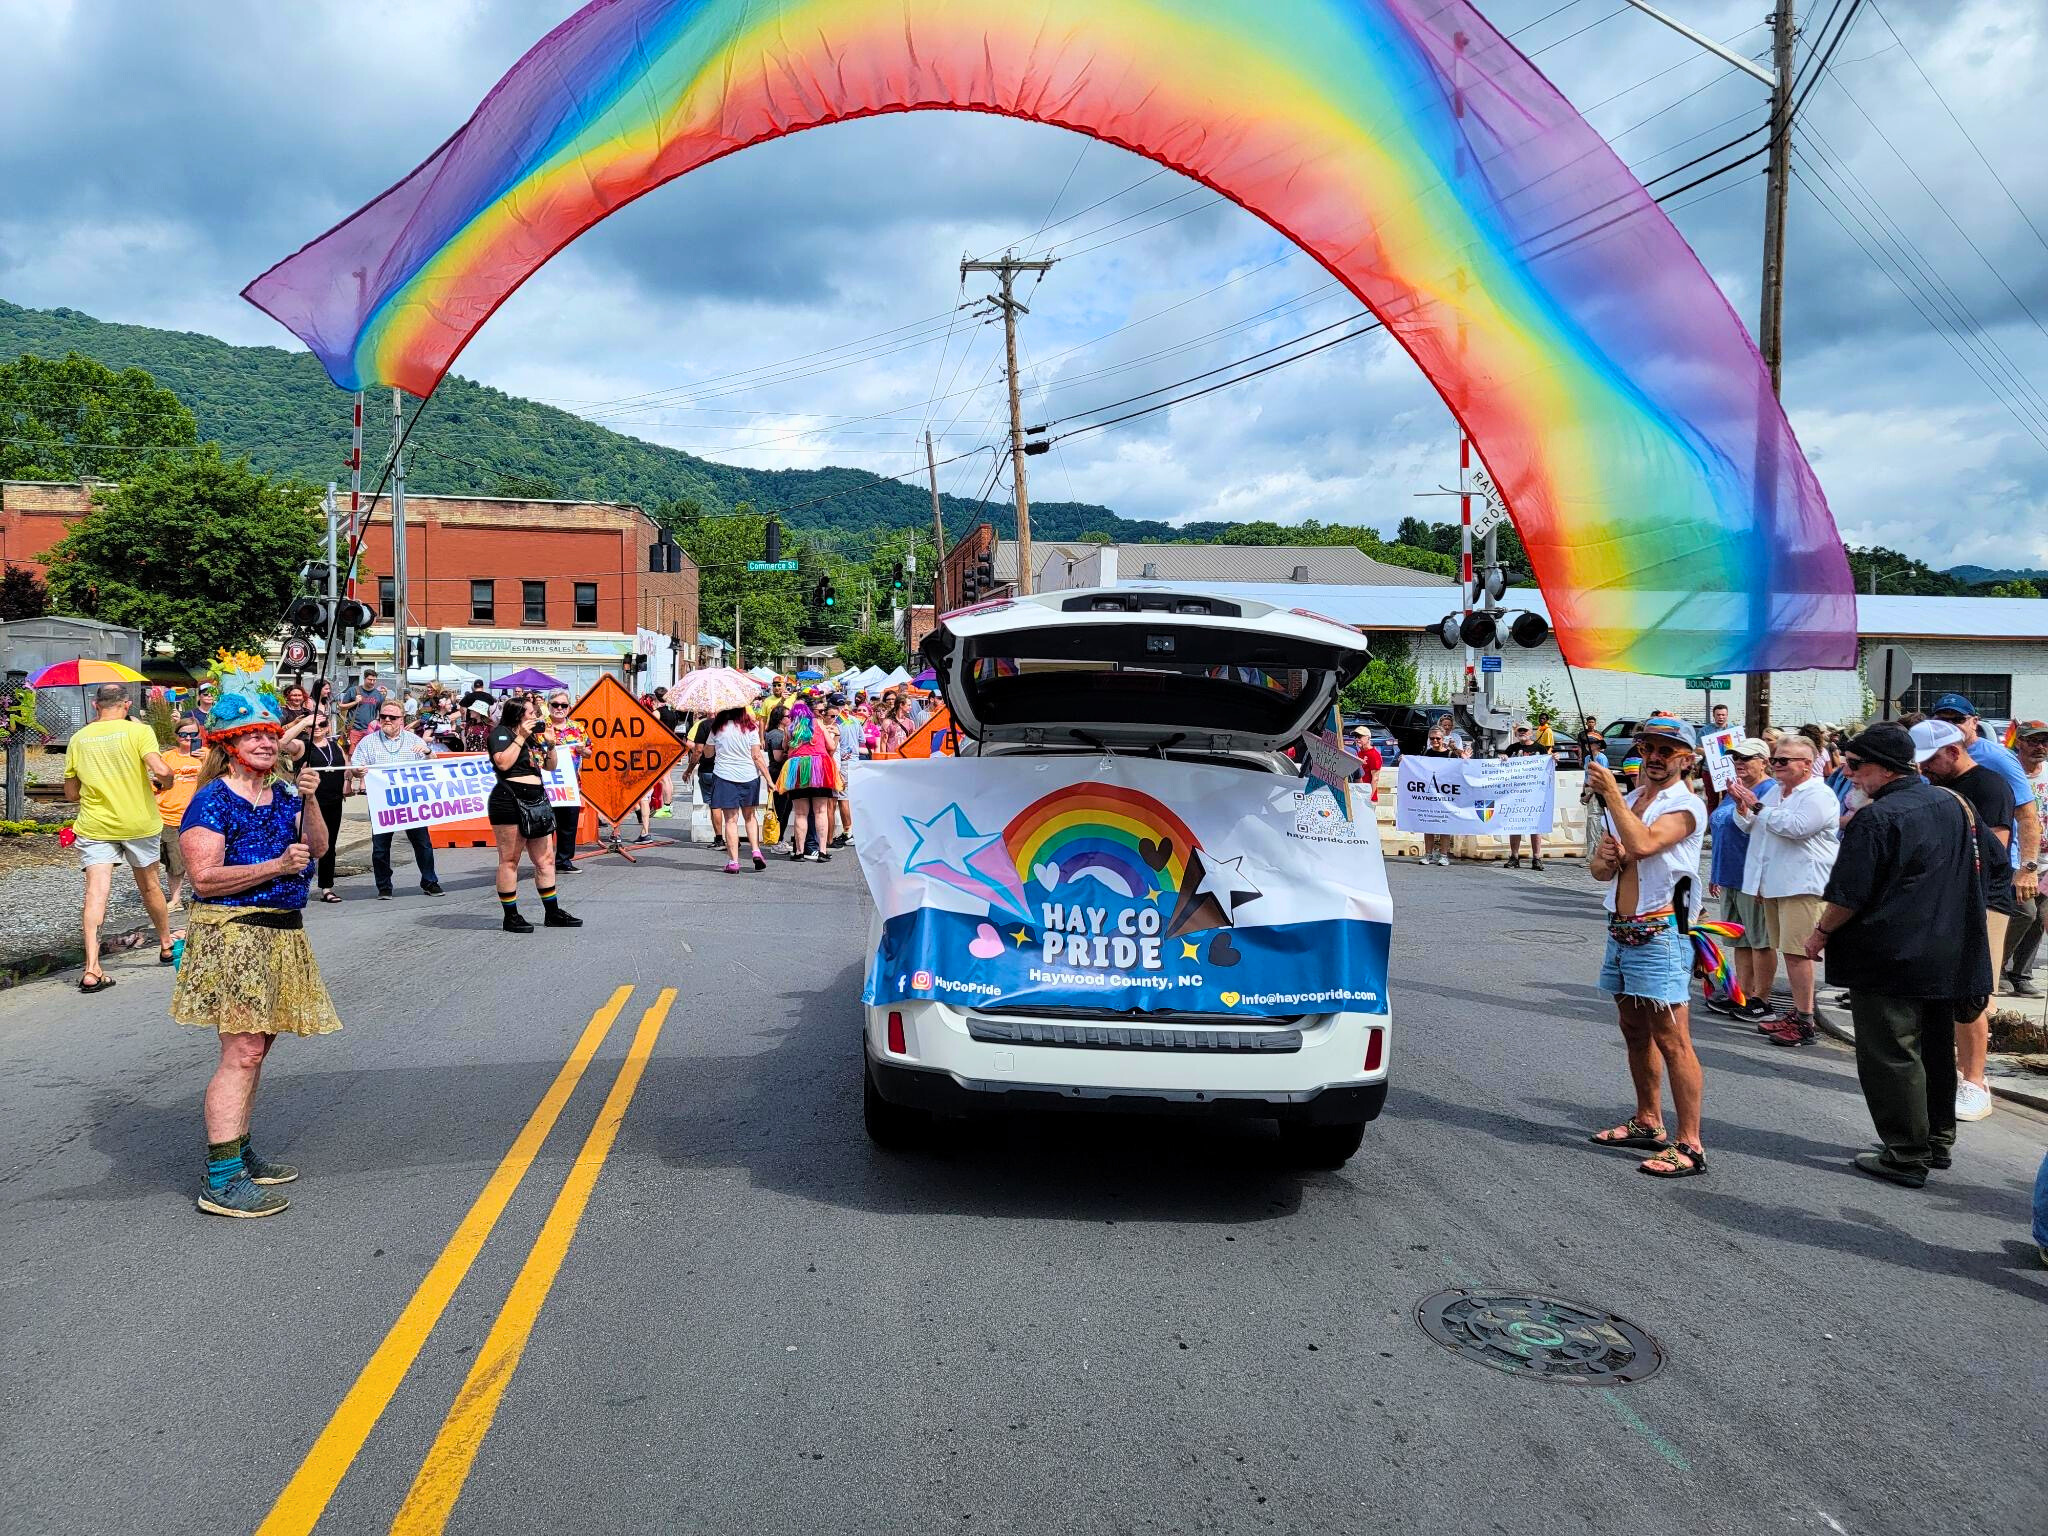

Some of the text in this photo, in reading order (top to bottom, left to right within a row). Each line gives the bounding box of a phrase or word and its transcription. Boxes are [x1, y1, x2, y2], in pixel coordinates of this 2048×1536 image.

[749, 561, 796, 570] Commerce St
[1686, 680, 1725, 689] BOUNDARY
[381, 765, 436, 786] THE
[1406, 771, 1461, 795] GRACE
[377, 796, 485, 827] WELCOMES
[1498, 801, 1547, 817] Episcopal
[1286, 831, 1369, 845] haycopride.com
[1041, 902, 1161, 936] HAY CO
[1042, 931, 1162, 969] PRIDE
[935, 975, 1002, 996] HayCoPride
[1029, 968, 1203, 990] Haywood County, NC
